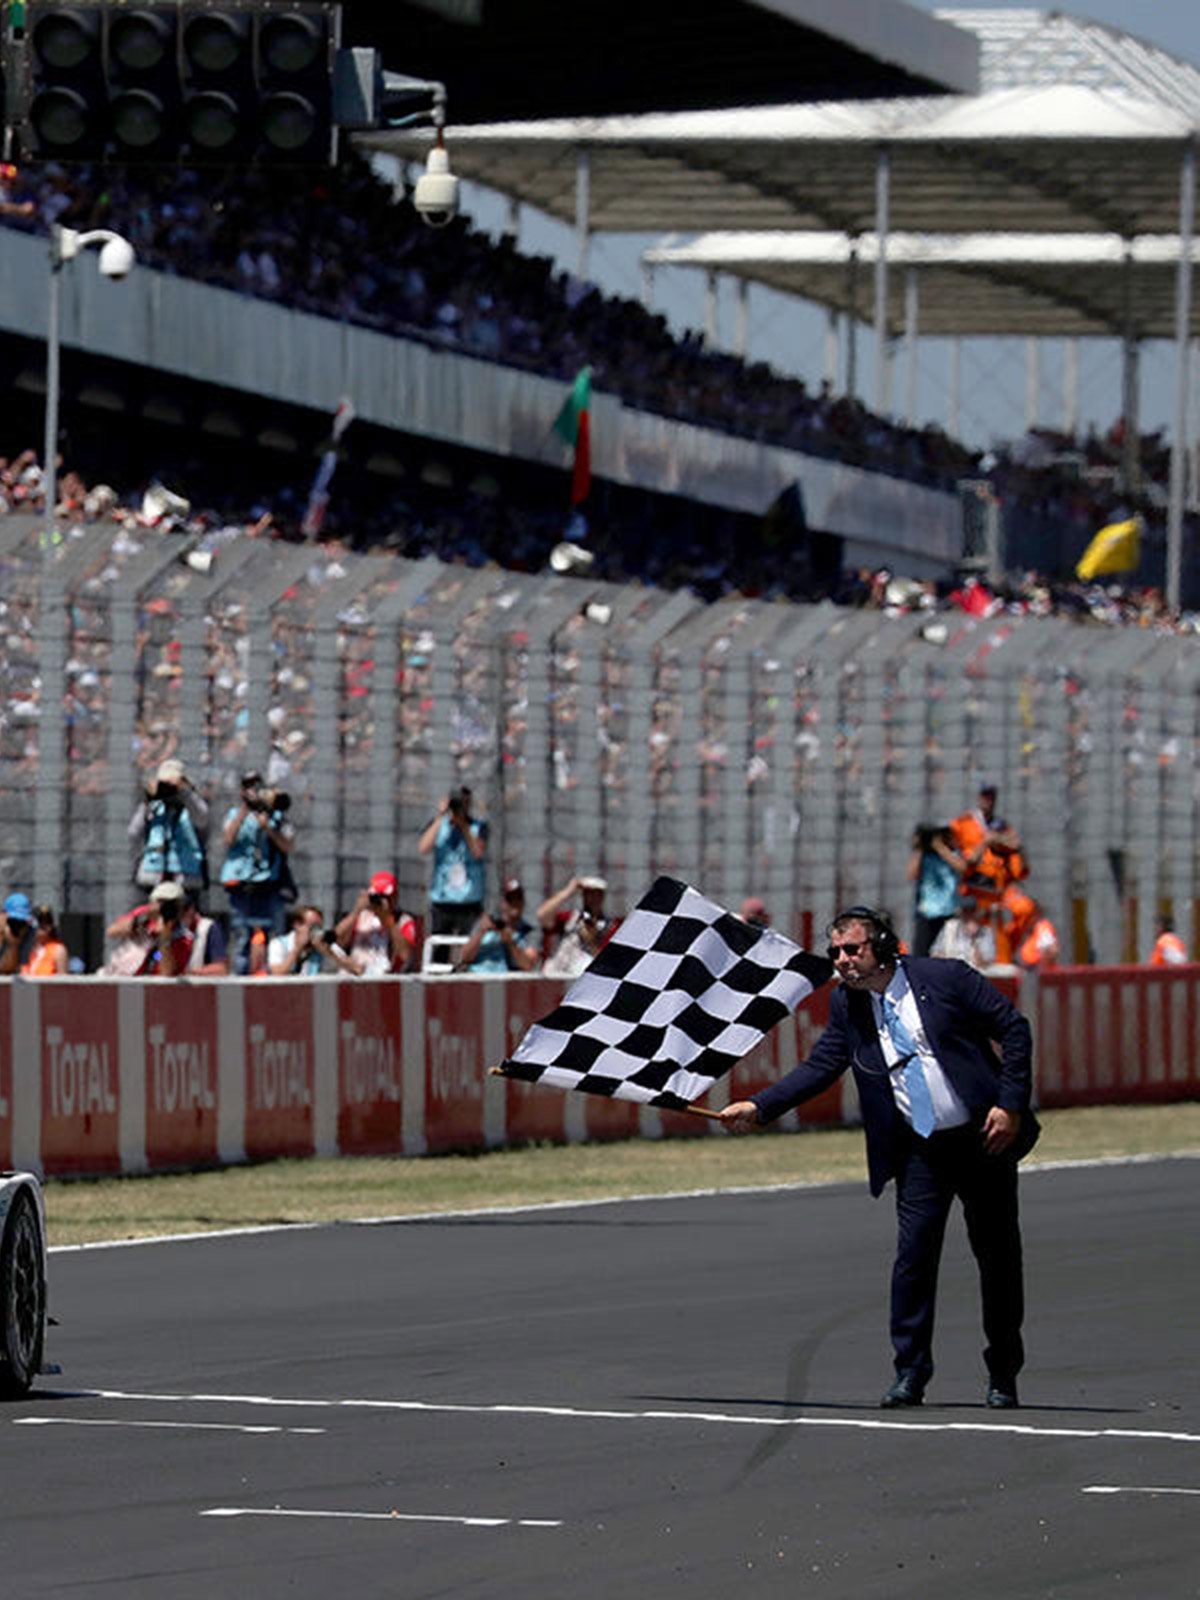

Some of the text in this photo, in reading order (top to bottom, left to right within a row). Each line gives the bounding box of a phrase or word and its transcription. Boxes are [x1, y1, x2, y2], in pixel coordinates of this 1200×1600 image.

[46, 1025, 115, 1117] TOTAL
[149, 1023, 214, 1113] TOTAL
[251, 1023, 311, 1109] TOTAL
